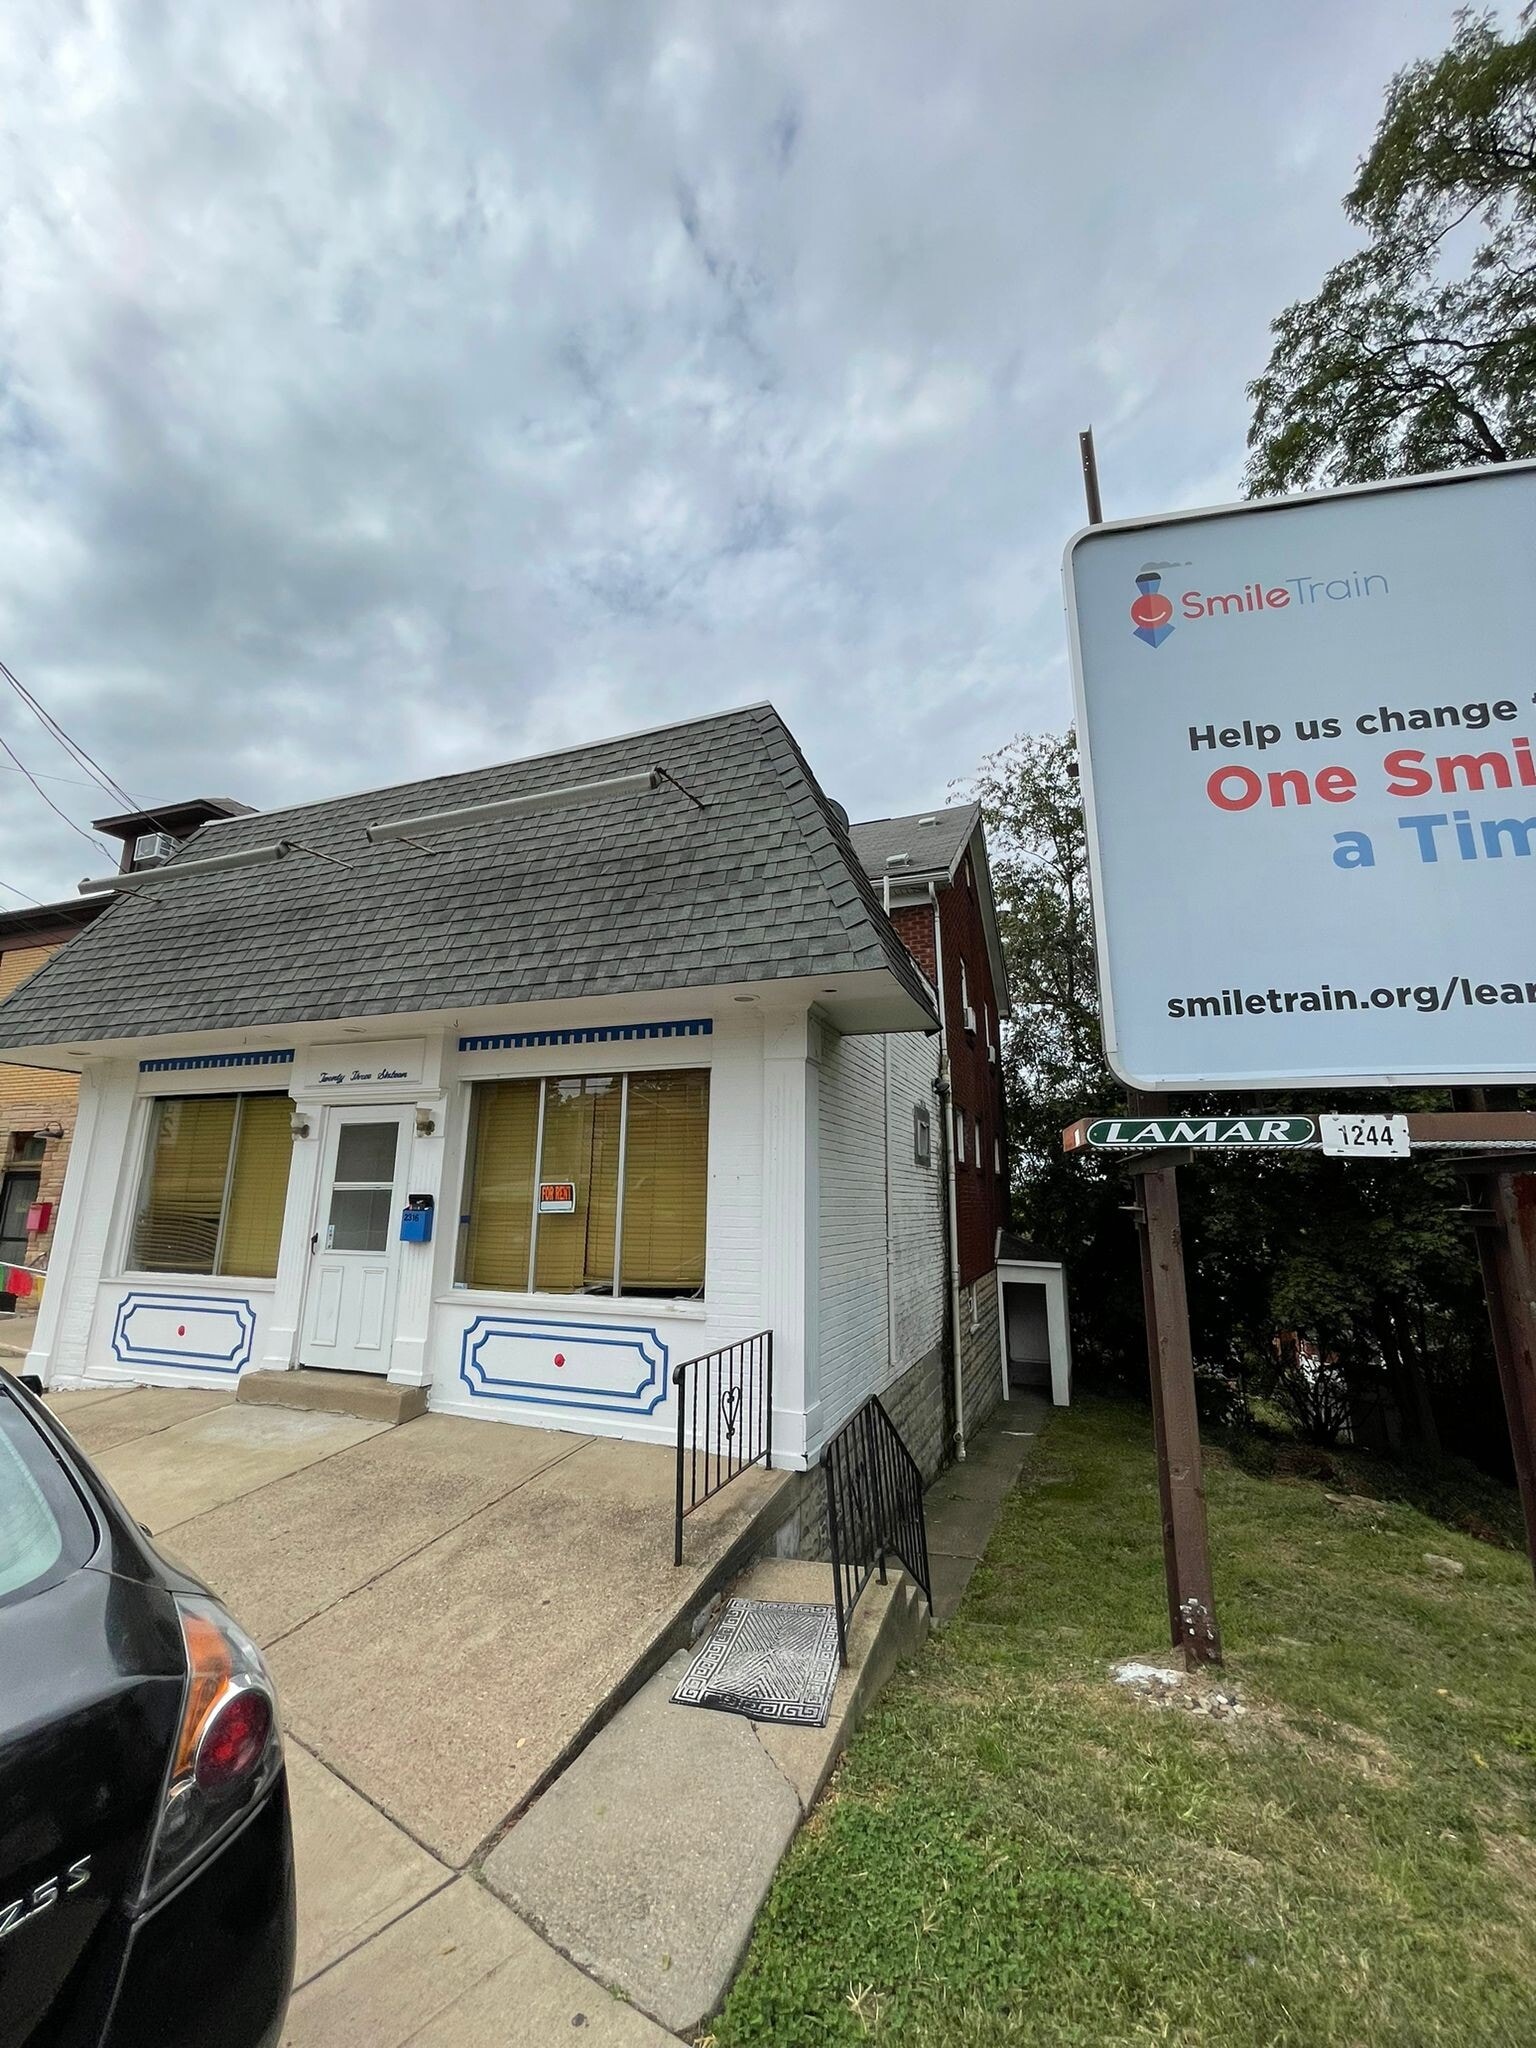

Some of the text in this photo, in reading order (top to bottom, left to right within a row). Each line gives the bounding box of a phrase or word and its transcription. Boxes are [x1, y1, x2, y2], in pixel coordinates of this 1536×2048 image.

[1182, 571, 1388, 619] SmileTrain
[1189, 700, 1517, 751] Help us change
[1207, 765, 1357, 812] One
[1333, 831, 1375, 869] a
[319, 1072, 345, 1083] Twenty
[377, 1068, 408, 1080] Sixteen
[1106, 1121, 1290, 1143] LAMAR
[1338, 1124, 1394, 1147] 1244
[542, 1186, 571, 1200] FOR RENT
